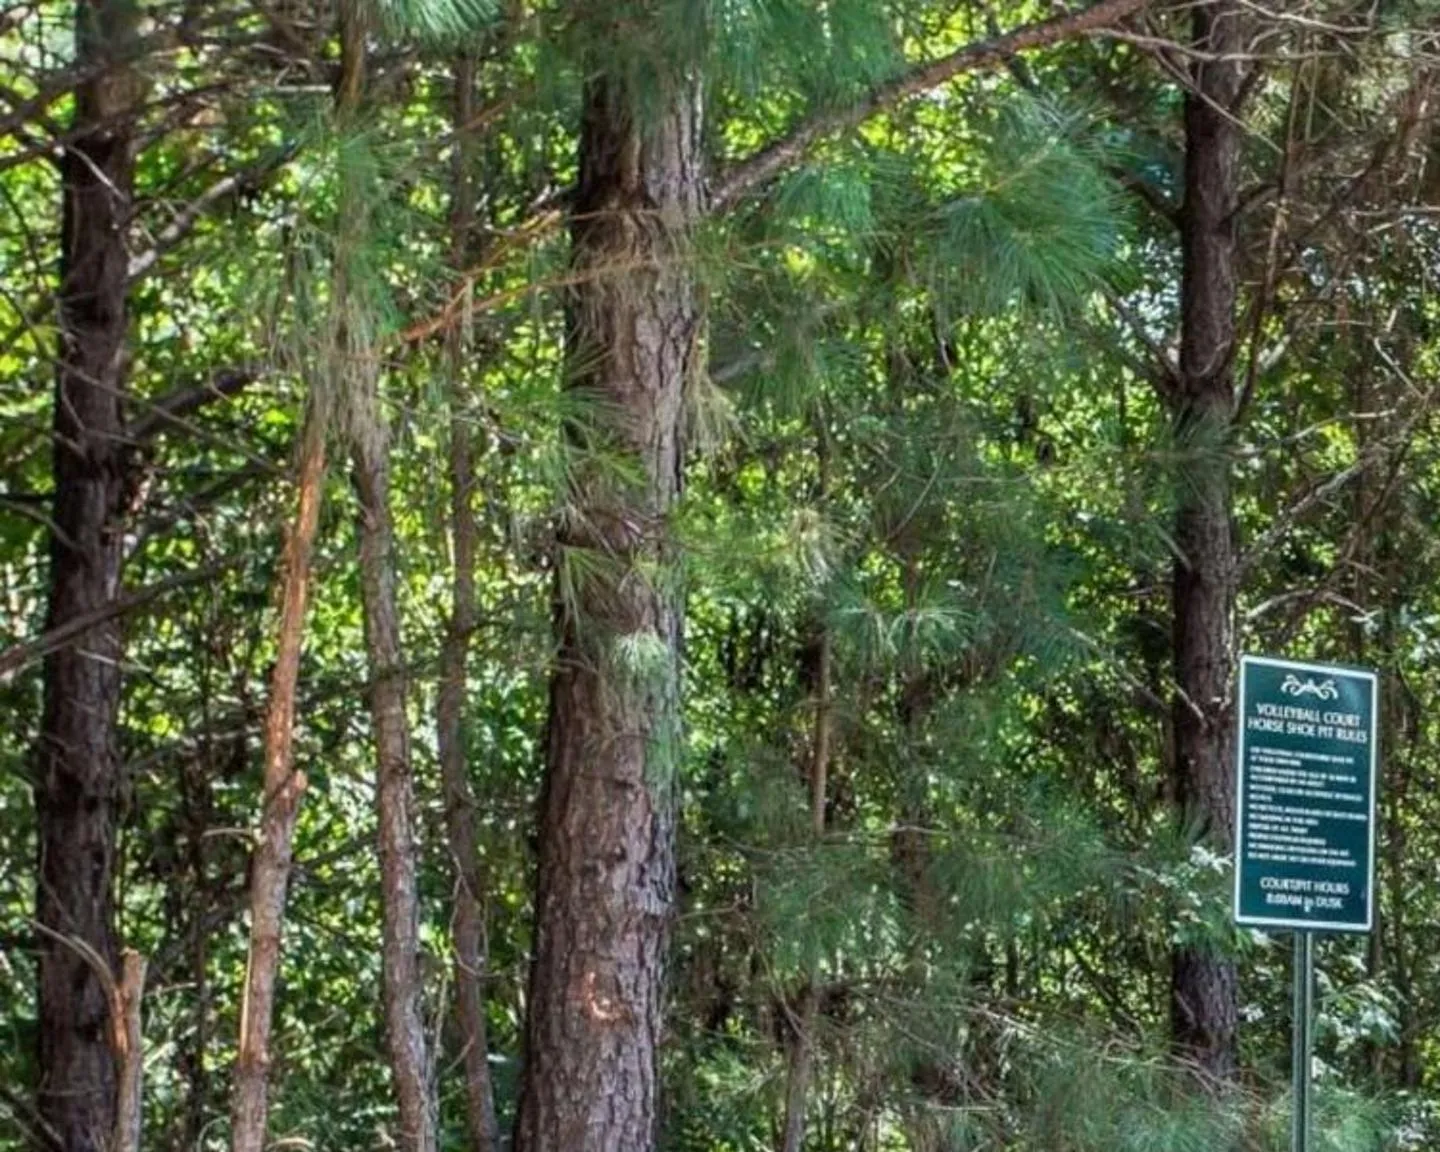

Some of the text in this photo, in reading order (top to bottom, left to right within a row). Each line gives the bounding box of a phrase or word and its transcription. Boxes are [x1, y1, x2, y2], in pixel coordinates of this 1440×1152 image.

[1256, 703, 1361, 727] VOLLEYBALL COURT
[1248, 716, 1284, 733] HORSE
[1286, 721, 1317, 738] SHOE
